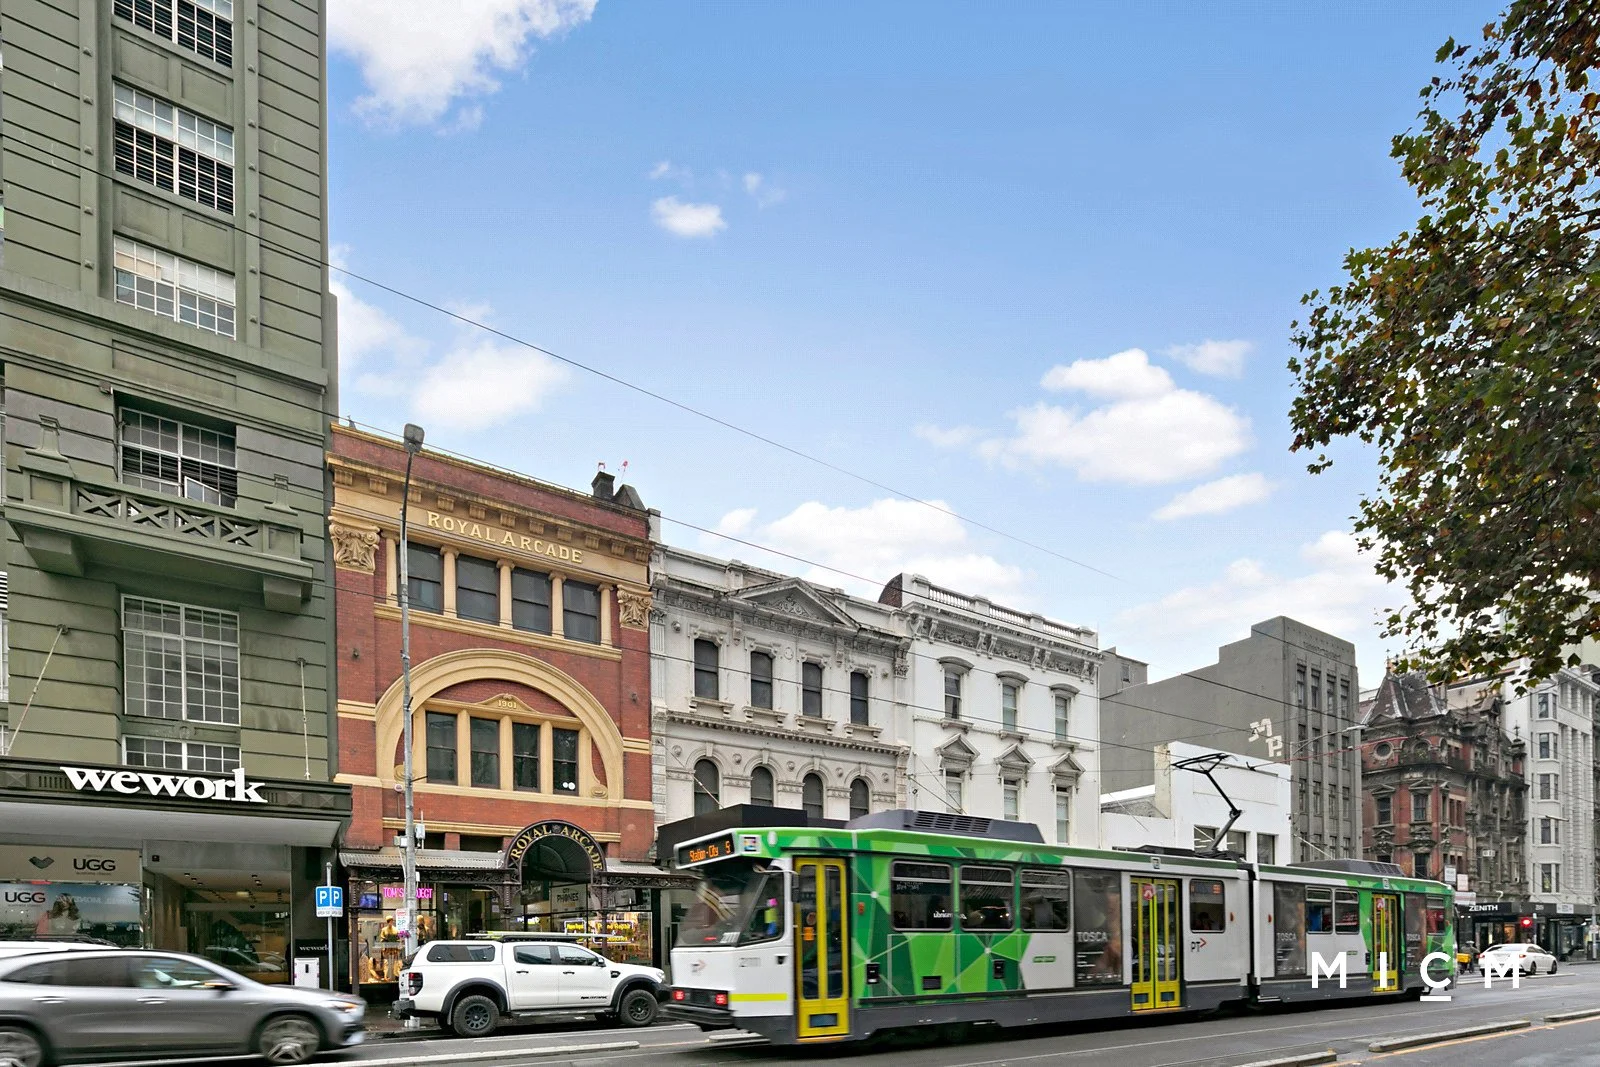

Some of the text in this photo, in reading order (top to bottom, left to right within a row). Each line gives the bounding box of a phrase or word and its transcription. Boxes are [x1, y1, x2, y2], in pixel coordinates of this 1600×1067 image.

[427, 510, 583, 563] ROYAL ARCADE
[498, 700, 517, 709] 1901
[60, 766, 268, 803] wework
[510, 825, 603, 871] ROYAL ARCADE
[690, 849, 706, 862] Station
[709, 845, 718, 858] City
[725, 840, 731, 854] 5
[73, 858, 116, 871] UGG
[5, 892, 46, 903] UGG
[320, 890, 328, 905] P
[333, 890, 340, 904] P
[383, 887, 404, 898] TOM'S
[1076, 931, 1108, 943] TOSCA
[1276, 932, 1297, 942] TOSCA
[1406, 933, 1421, 942] TOSCA
